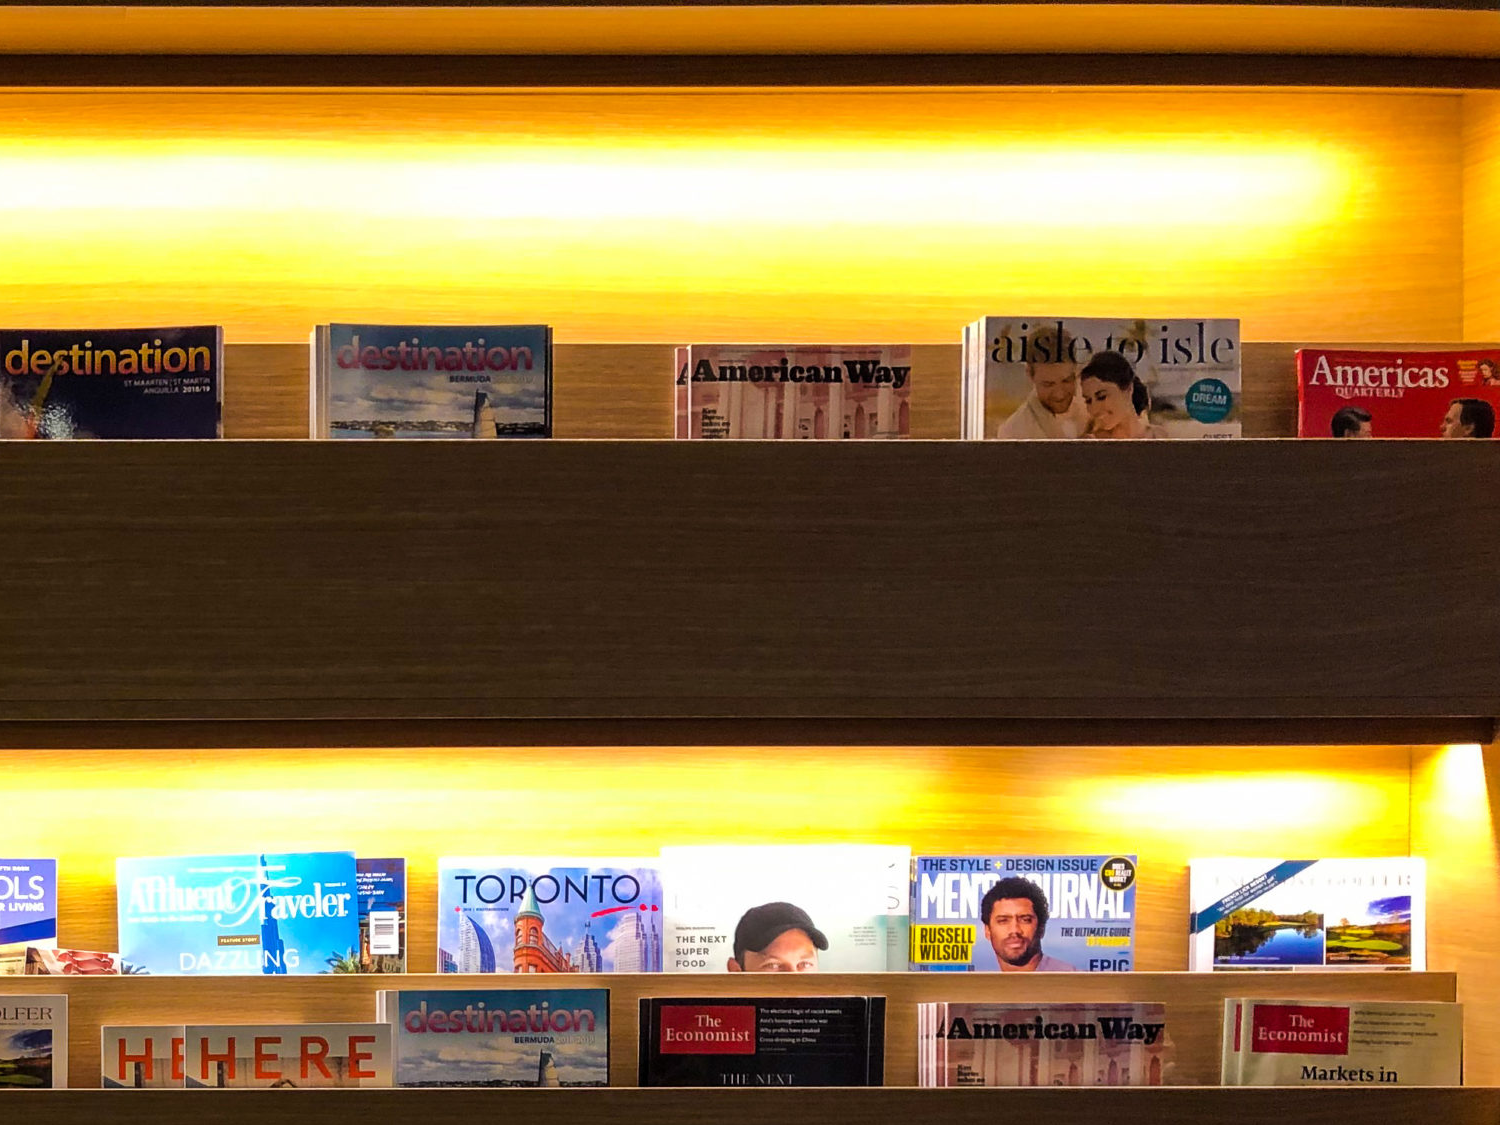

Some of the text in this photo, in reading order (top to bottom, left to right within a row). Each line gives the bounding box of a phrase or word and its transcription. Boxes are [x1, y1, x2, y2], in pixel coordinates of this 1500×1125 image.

[991, 321, 1093, 363] aisle
[1160, 322, 1235, 365] isle
[5, 339, 211, 375] destination
[336, 335, 533, 371] destination
[691, 358, 843, 383] American
[843, 360, 911, 389] Way
[1308, 355, 1450, 388] Americas
[449, 375, 492, 383] BERMUDA
[1192, 392, 1227, 405] DREAM
[1335, 387, 1405, 400] QUARTERLY
[921, 859, 947, 871] THE
[949, 859, 992, 871] STYLE
[1006, 859, 1056, 871] DESIGN
[1058, 858, 1098, 871] ISSUE
[454, 874, 641, 904] TORONTO
[8, 902, 45, 912] LIVING
[676, 935, 727, 943] THE NEXT
[920, 927, 974, 944] RUSSELL
[1061, 927, 1131, 937] THE ULTIMATE GUIDE
[675, 947, 710, 956] SUPER
[920, 944, 969, 961] WILSON
[675, 959, 706, 968] FOOD
[1089, 959, 1130, 972] EPIC
[404, 1001, 595, 1034] destination
[695, 1014, 722, 1028] The
[1288, 1014, 1315, 1028] The
[665, 1027, 750, 1042] Economist
[947, 1015, 1098, 1040] American
[1097, 1017, 1166, 1045] Way
[1257, 1026, 1344, 1043] Economist
[514, 1036, 555, 1044] BERMUDA
[200, 1036, 376, 1080] HERE
[720, 1072, 795, 1085] THE NEXT
[1300, 1065, 1398, 1082] Markets in
